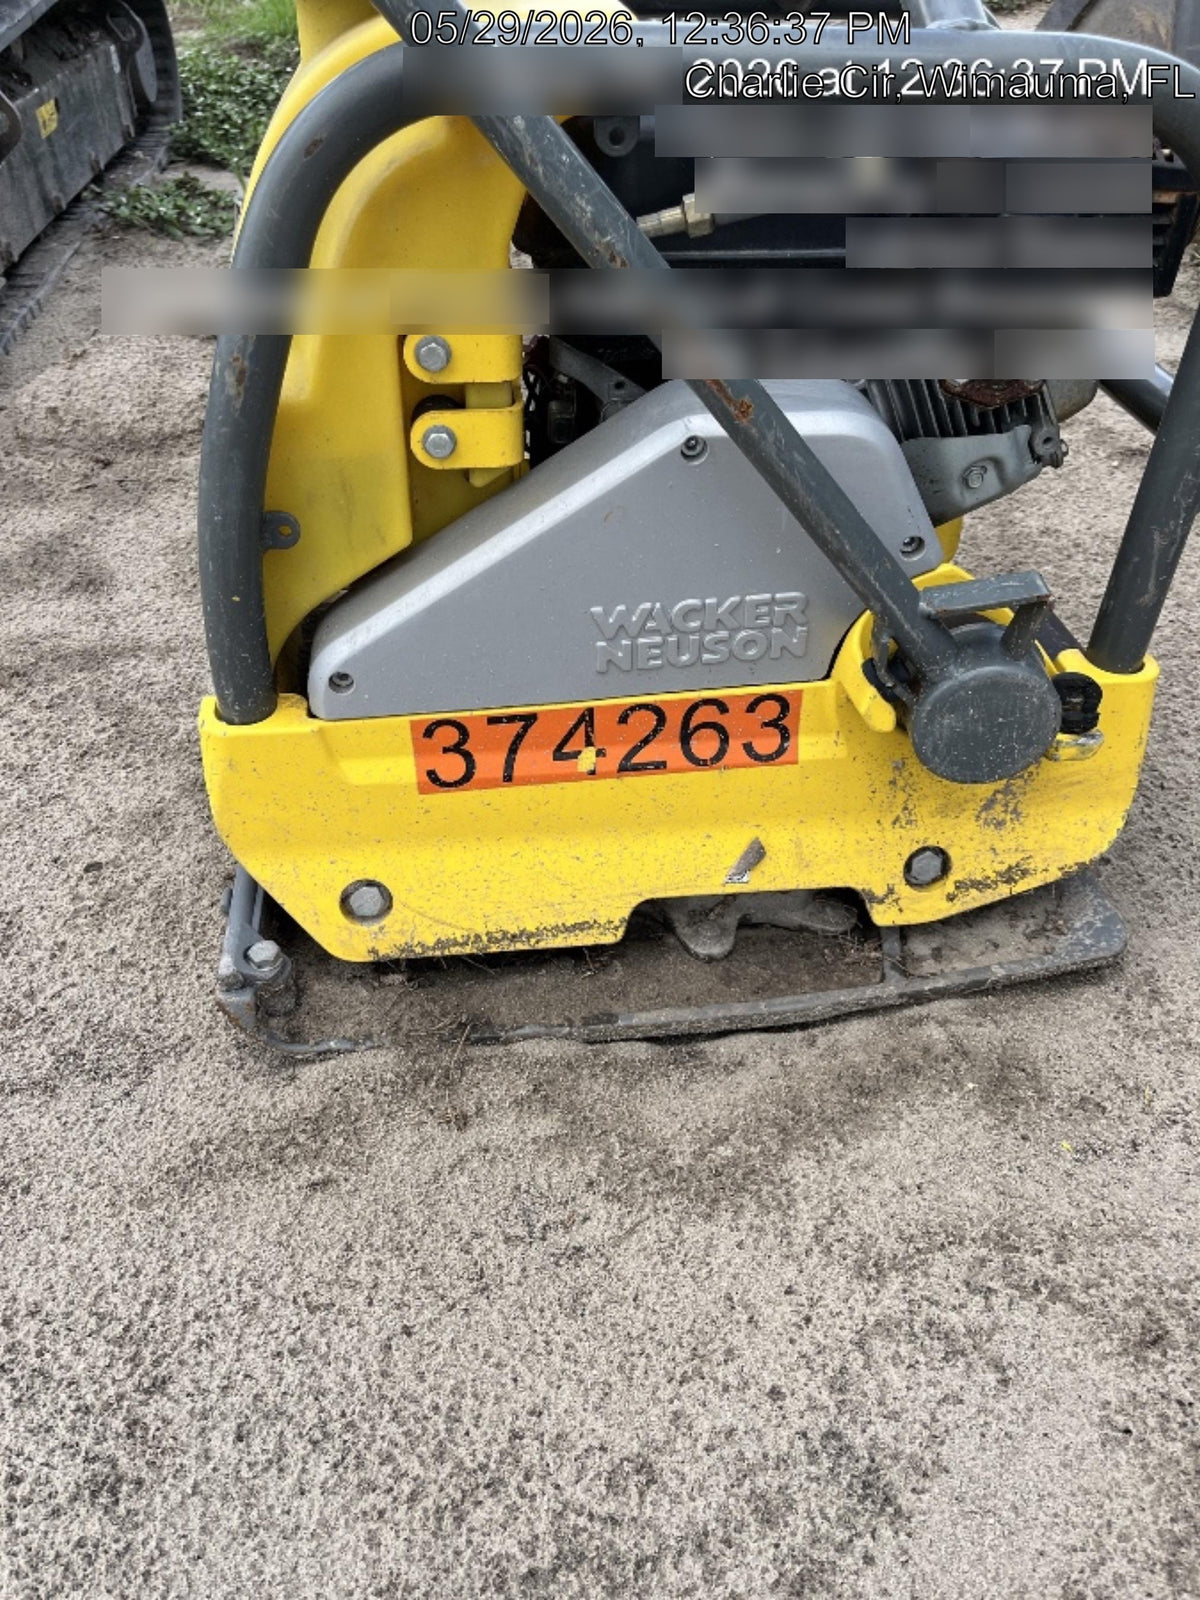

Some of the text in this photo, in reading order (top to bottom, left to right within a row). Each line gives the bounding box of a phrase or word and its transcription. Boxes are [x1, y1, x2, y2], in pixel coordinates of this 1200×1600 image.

[590, 592, 808, 640] WACKER
[595, 627, 808, 674] NEUSON
[422, 693, 791, 788] 374263
